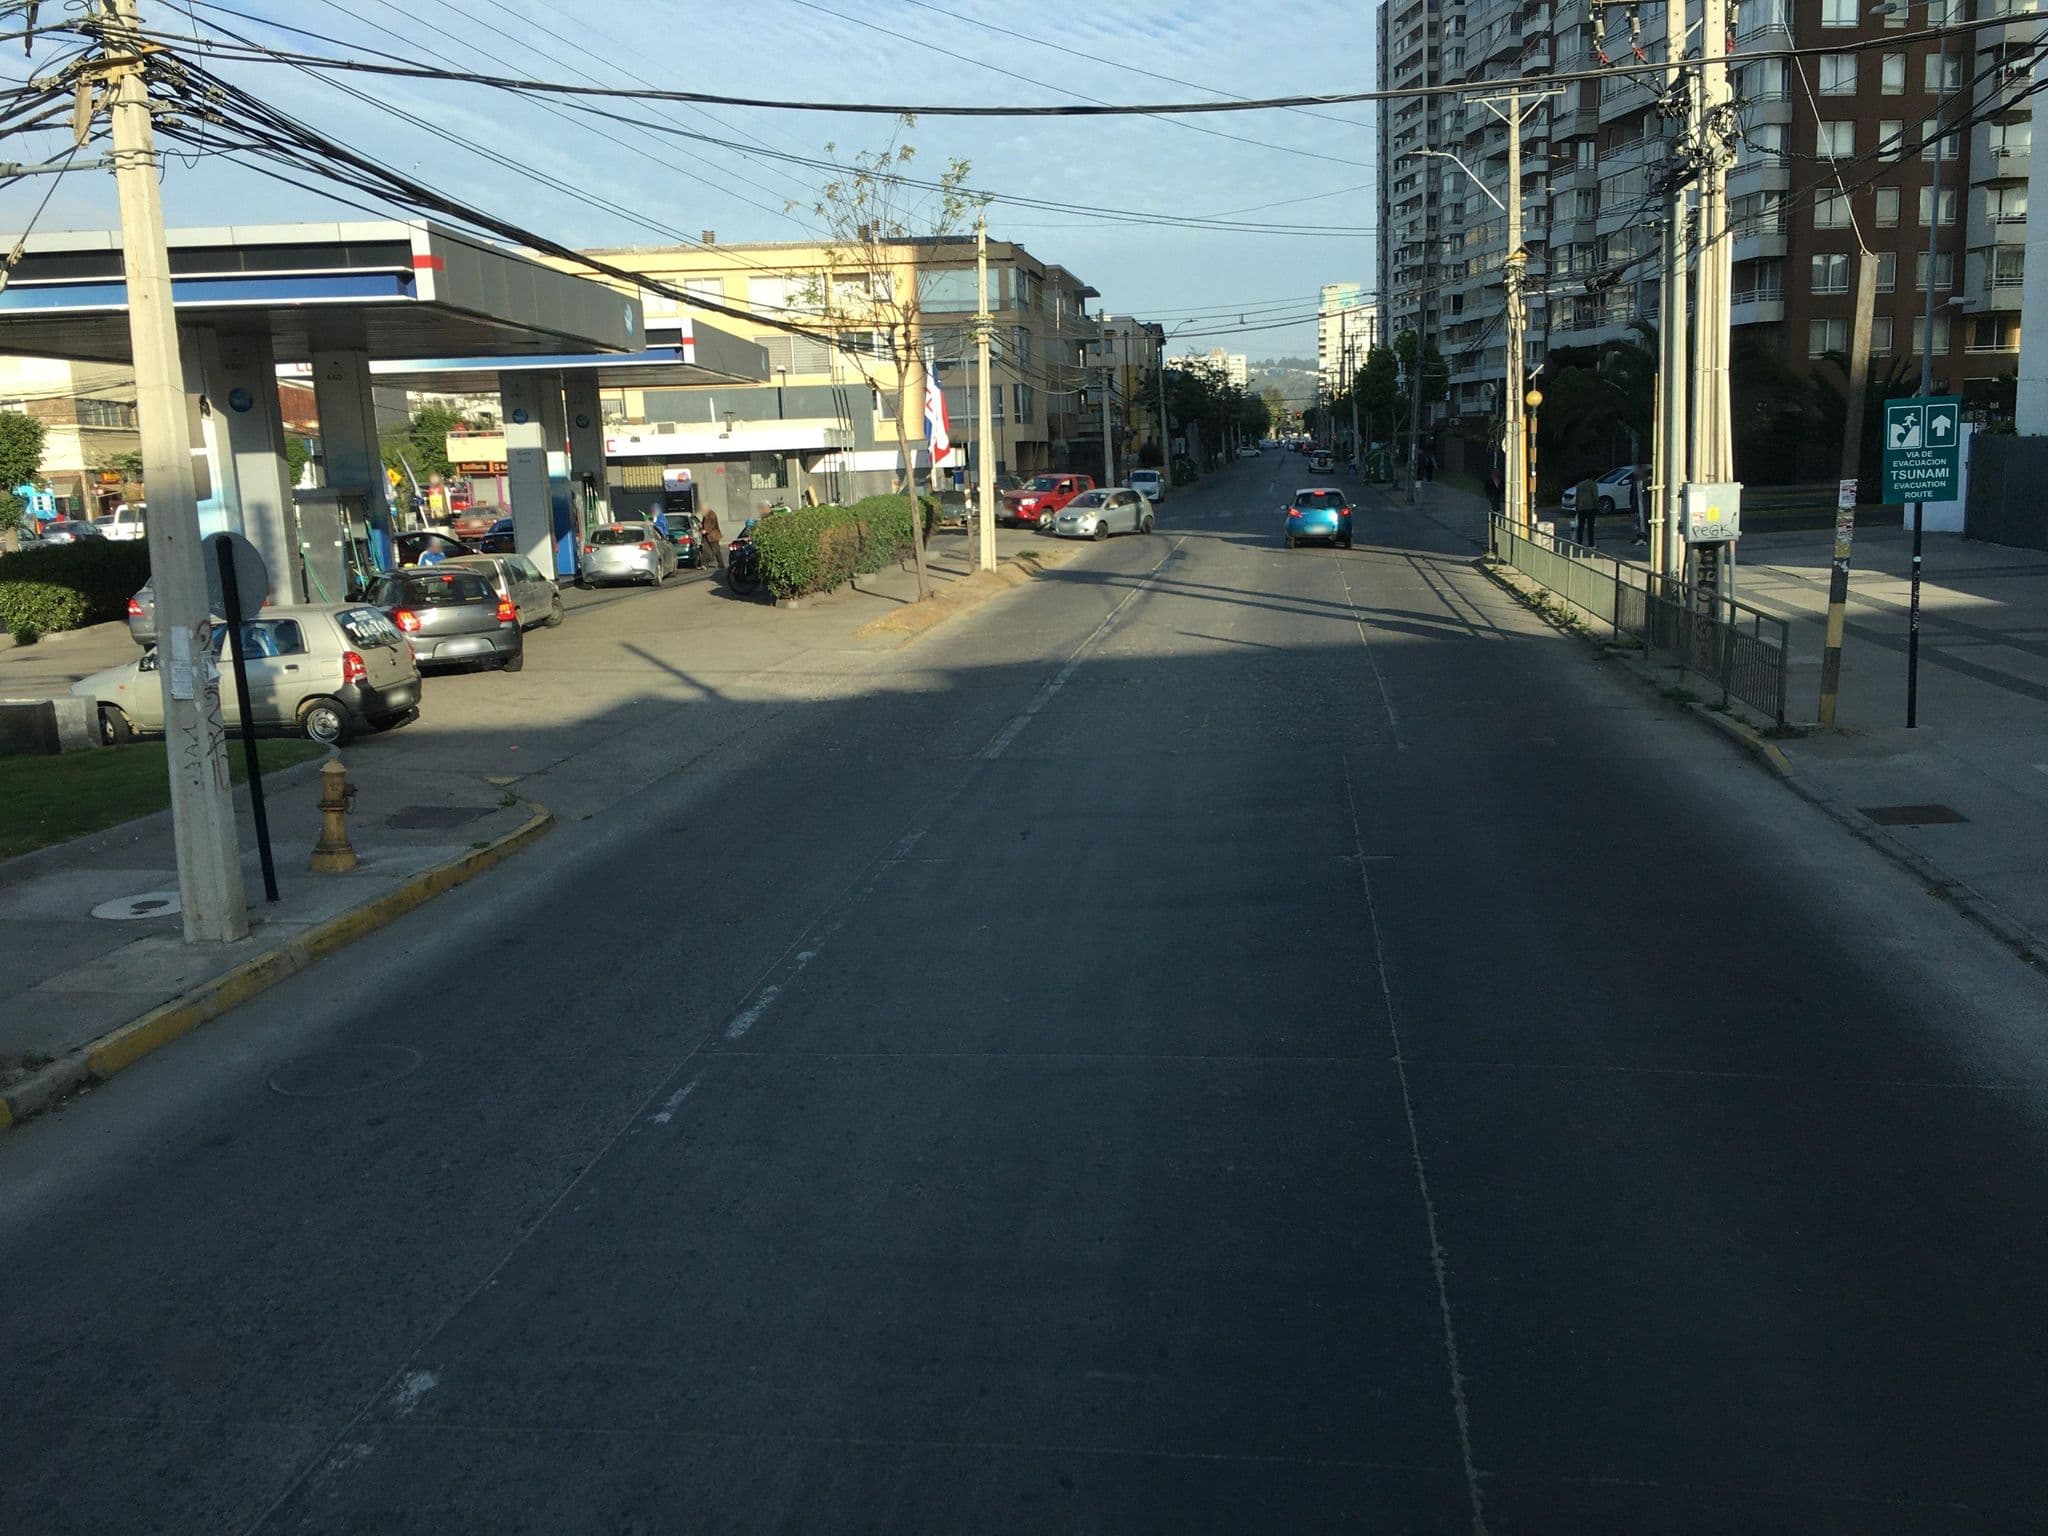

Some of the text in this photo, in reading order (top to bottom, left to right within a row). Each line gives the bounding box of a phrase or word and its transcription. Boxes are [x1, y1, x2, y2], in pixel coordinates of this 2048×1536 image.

[1921, 450, 1933, 458] DE
[1892, 458, 1947, 468] EVACUACION
[1890, 467, 1950, 480] TSUNAMI
[1893, 480, 1947, 490] EVACUATION
[1904, 490, 1934, 499] ROUTE
